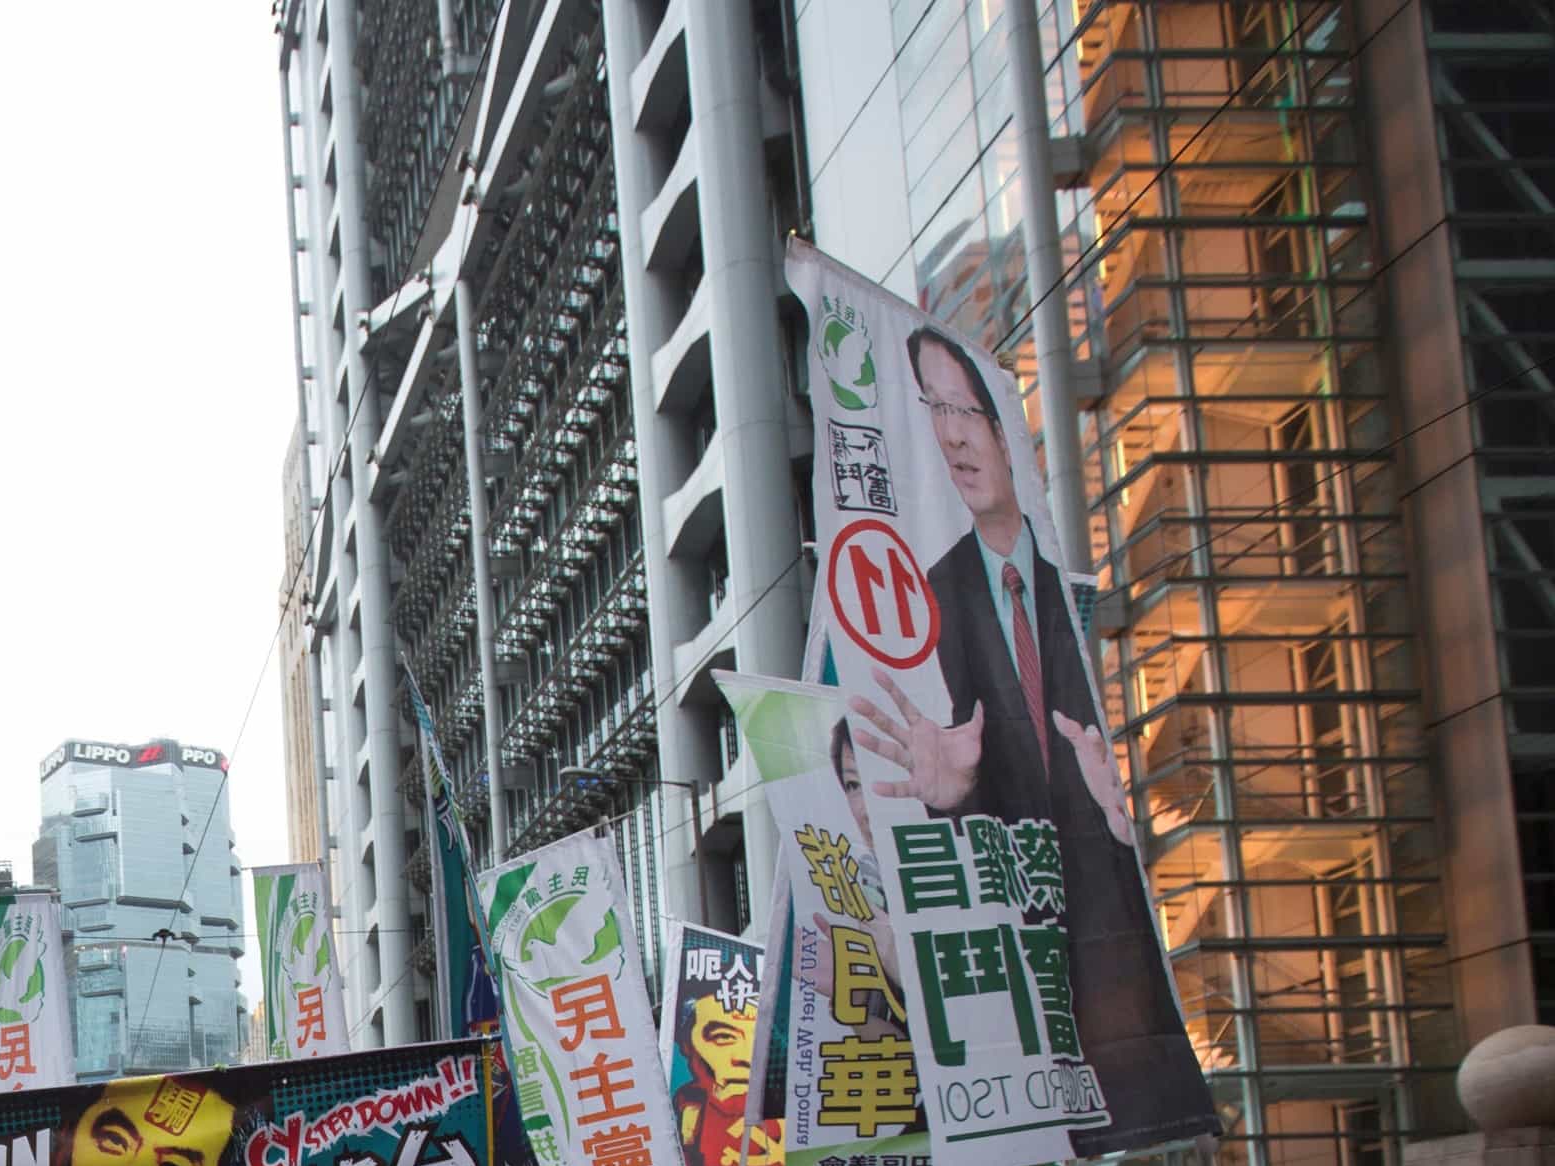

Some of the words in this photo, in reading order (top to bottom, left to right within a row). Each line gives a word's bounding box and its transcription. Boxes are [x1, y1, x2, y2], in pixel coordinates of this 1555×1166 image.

[73, 742, 131, 765] LIPPO
[303, 1105, 354, 1151] STEP
[356, 1056, 477, 1131] DOWN!!
